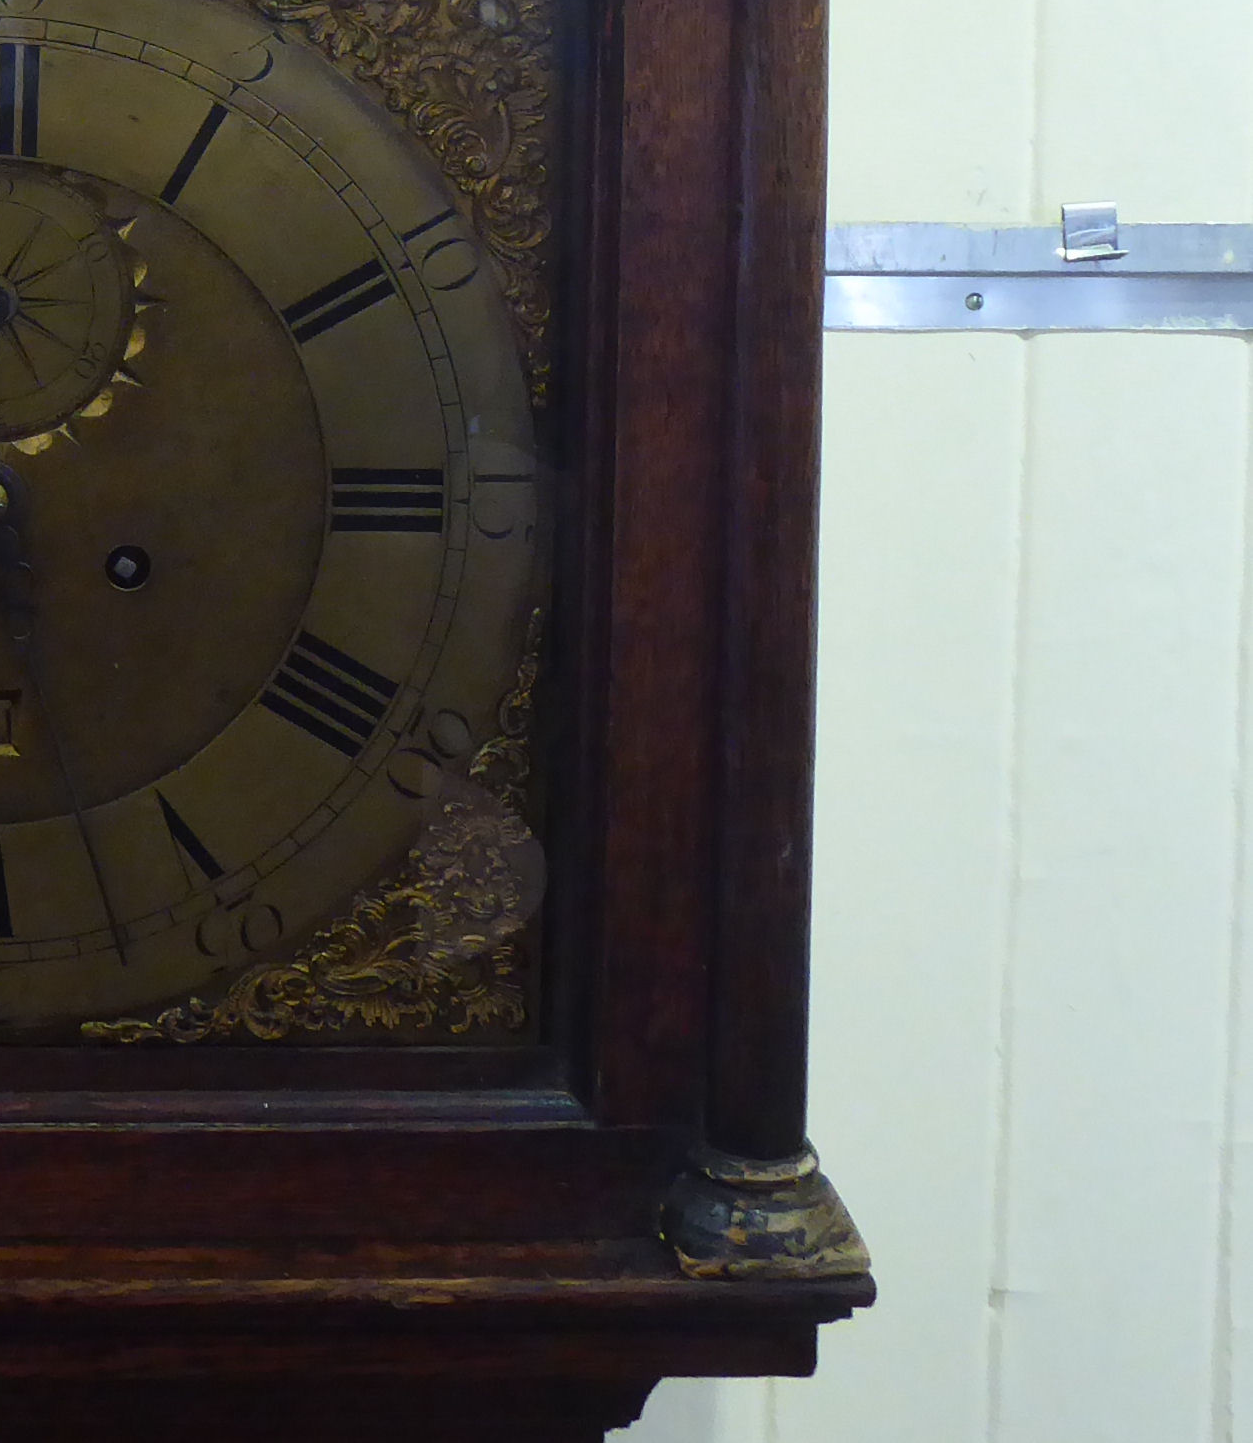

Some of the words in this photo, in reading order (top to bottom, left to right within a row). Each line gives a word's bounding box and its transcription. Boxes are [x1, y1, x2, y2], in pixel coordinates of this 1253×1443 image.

[158, 97, 230, 206] I
[401, 207, 480, 292] 10
[279, 257, 398, 346] II
[330, 467, 444, 534] III
[253, 630, 401, 759] IIII
[152, 786, 226, 891] V
